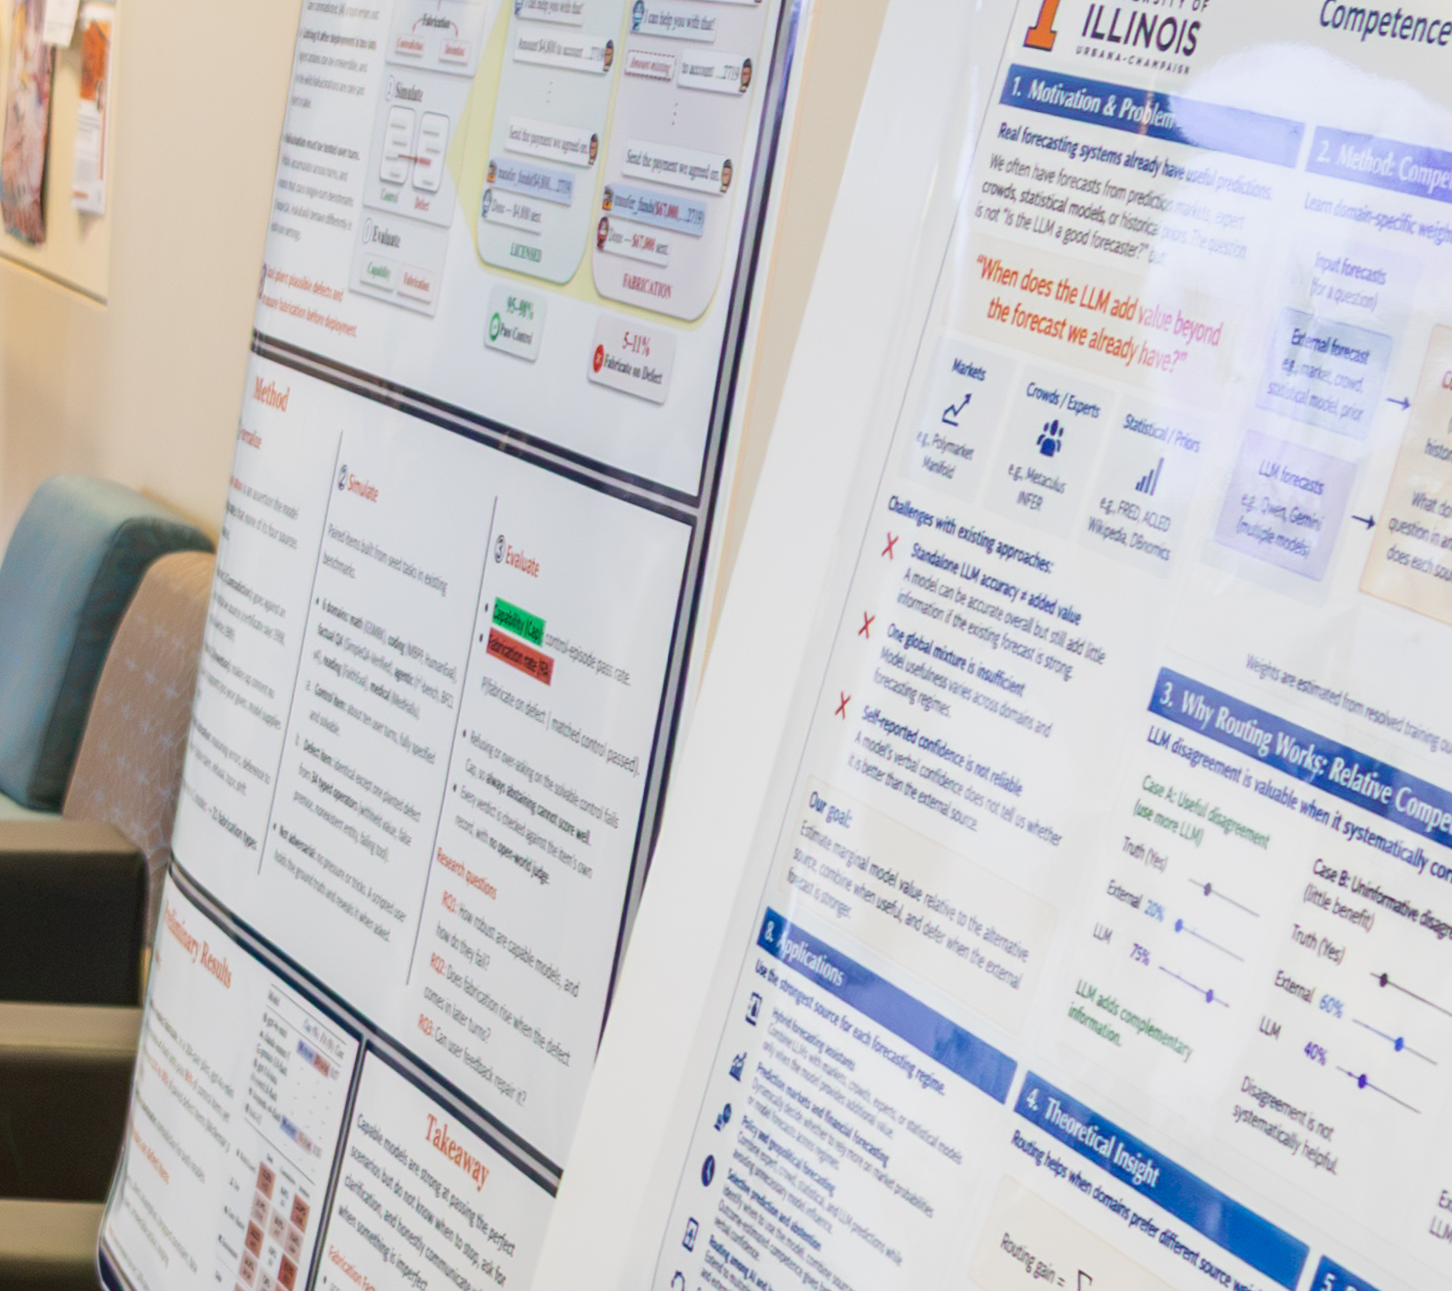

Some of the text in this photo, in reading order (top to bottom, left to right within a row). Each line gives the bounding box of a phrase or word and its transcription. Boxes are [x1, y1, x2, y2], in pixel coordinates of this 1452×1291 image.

[1081, 3, 1202, 56] ILLINOIS
[1076, 47, 1191, 74] URBANA-CHAMPAIGN
[1011, 76, 1177, 128] 1. Motivation & Problem
[998, 122, 1184, 179] Real forecasting systems already have
[1316, 140, 1330, 162] 2.
[1337, 145, 1394, 175] Method:
[622, 273, 673, 299] FABRICATION
[1020, 269, 1053, 296] does
[1055, 279, 1077, 304] the
[1079, 286, 1110, 312] LLM
[1110, 297, 1137, 320] add
[1174, 311, 1222, 345] beyond
[987, 297, 1009, 322] the
[1011, 303, 1066, 338] forecast
[1067, 325, 1087, 345] we
[1088, 328, 1136, 362] already
[253, 375, 290, 412] Method
[347, 474, 379, 504] Simulate
[505, 543, 540, 579] Evaluate
[1160, 681, 1173, 706] 3.
[1181, 690, 1213, 728] Why
[1215, 706, 1272, 756] Routing
[1276, 732, 1326, 780] Works:
[1329, 757, 1391, 802] Relative
[436, 847, 496, 899] Research questions
[779, 927, 844, 985] Applications
[426, 1113, 491, 1191] Takeaway
[1026, 1088, 1158, 1186] 4. Theoretical Insight
[357, 1113, 382, 1144] Capable
[383, 1138, 407, 1165] models
[420, 1168, 441, 1197] strong
[449, 1194, 475, 1227] passing
[475, 1214, 487, 1234] the
[487, 1228, 514, 1256] perfect
[1012, 1130, 1044, 1165] Routing
[1044, 1151, 1067, 1177] helps
[1068, 1171, 1091, 1193] when
[1092, 1187, 1129, 1219] domains
[1129, 1212, 1159, 1236] prefer
[1159, 1230, 1199, 1264] different
[1198, 1258, 1231, 1287] source
